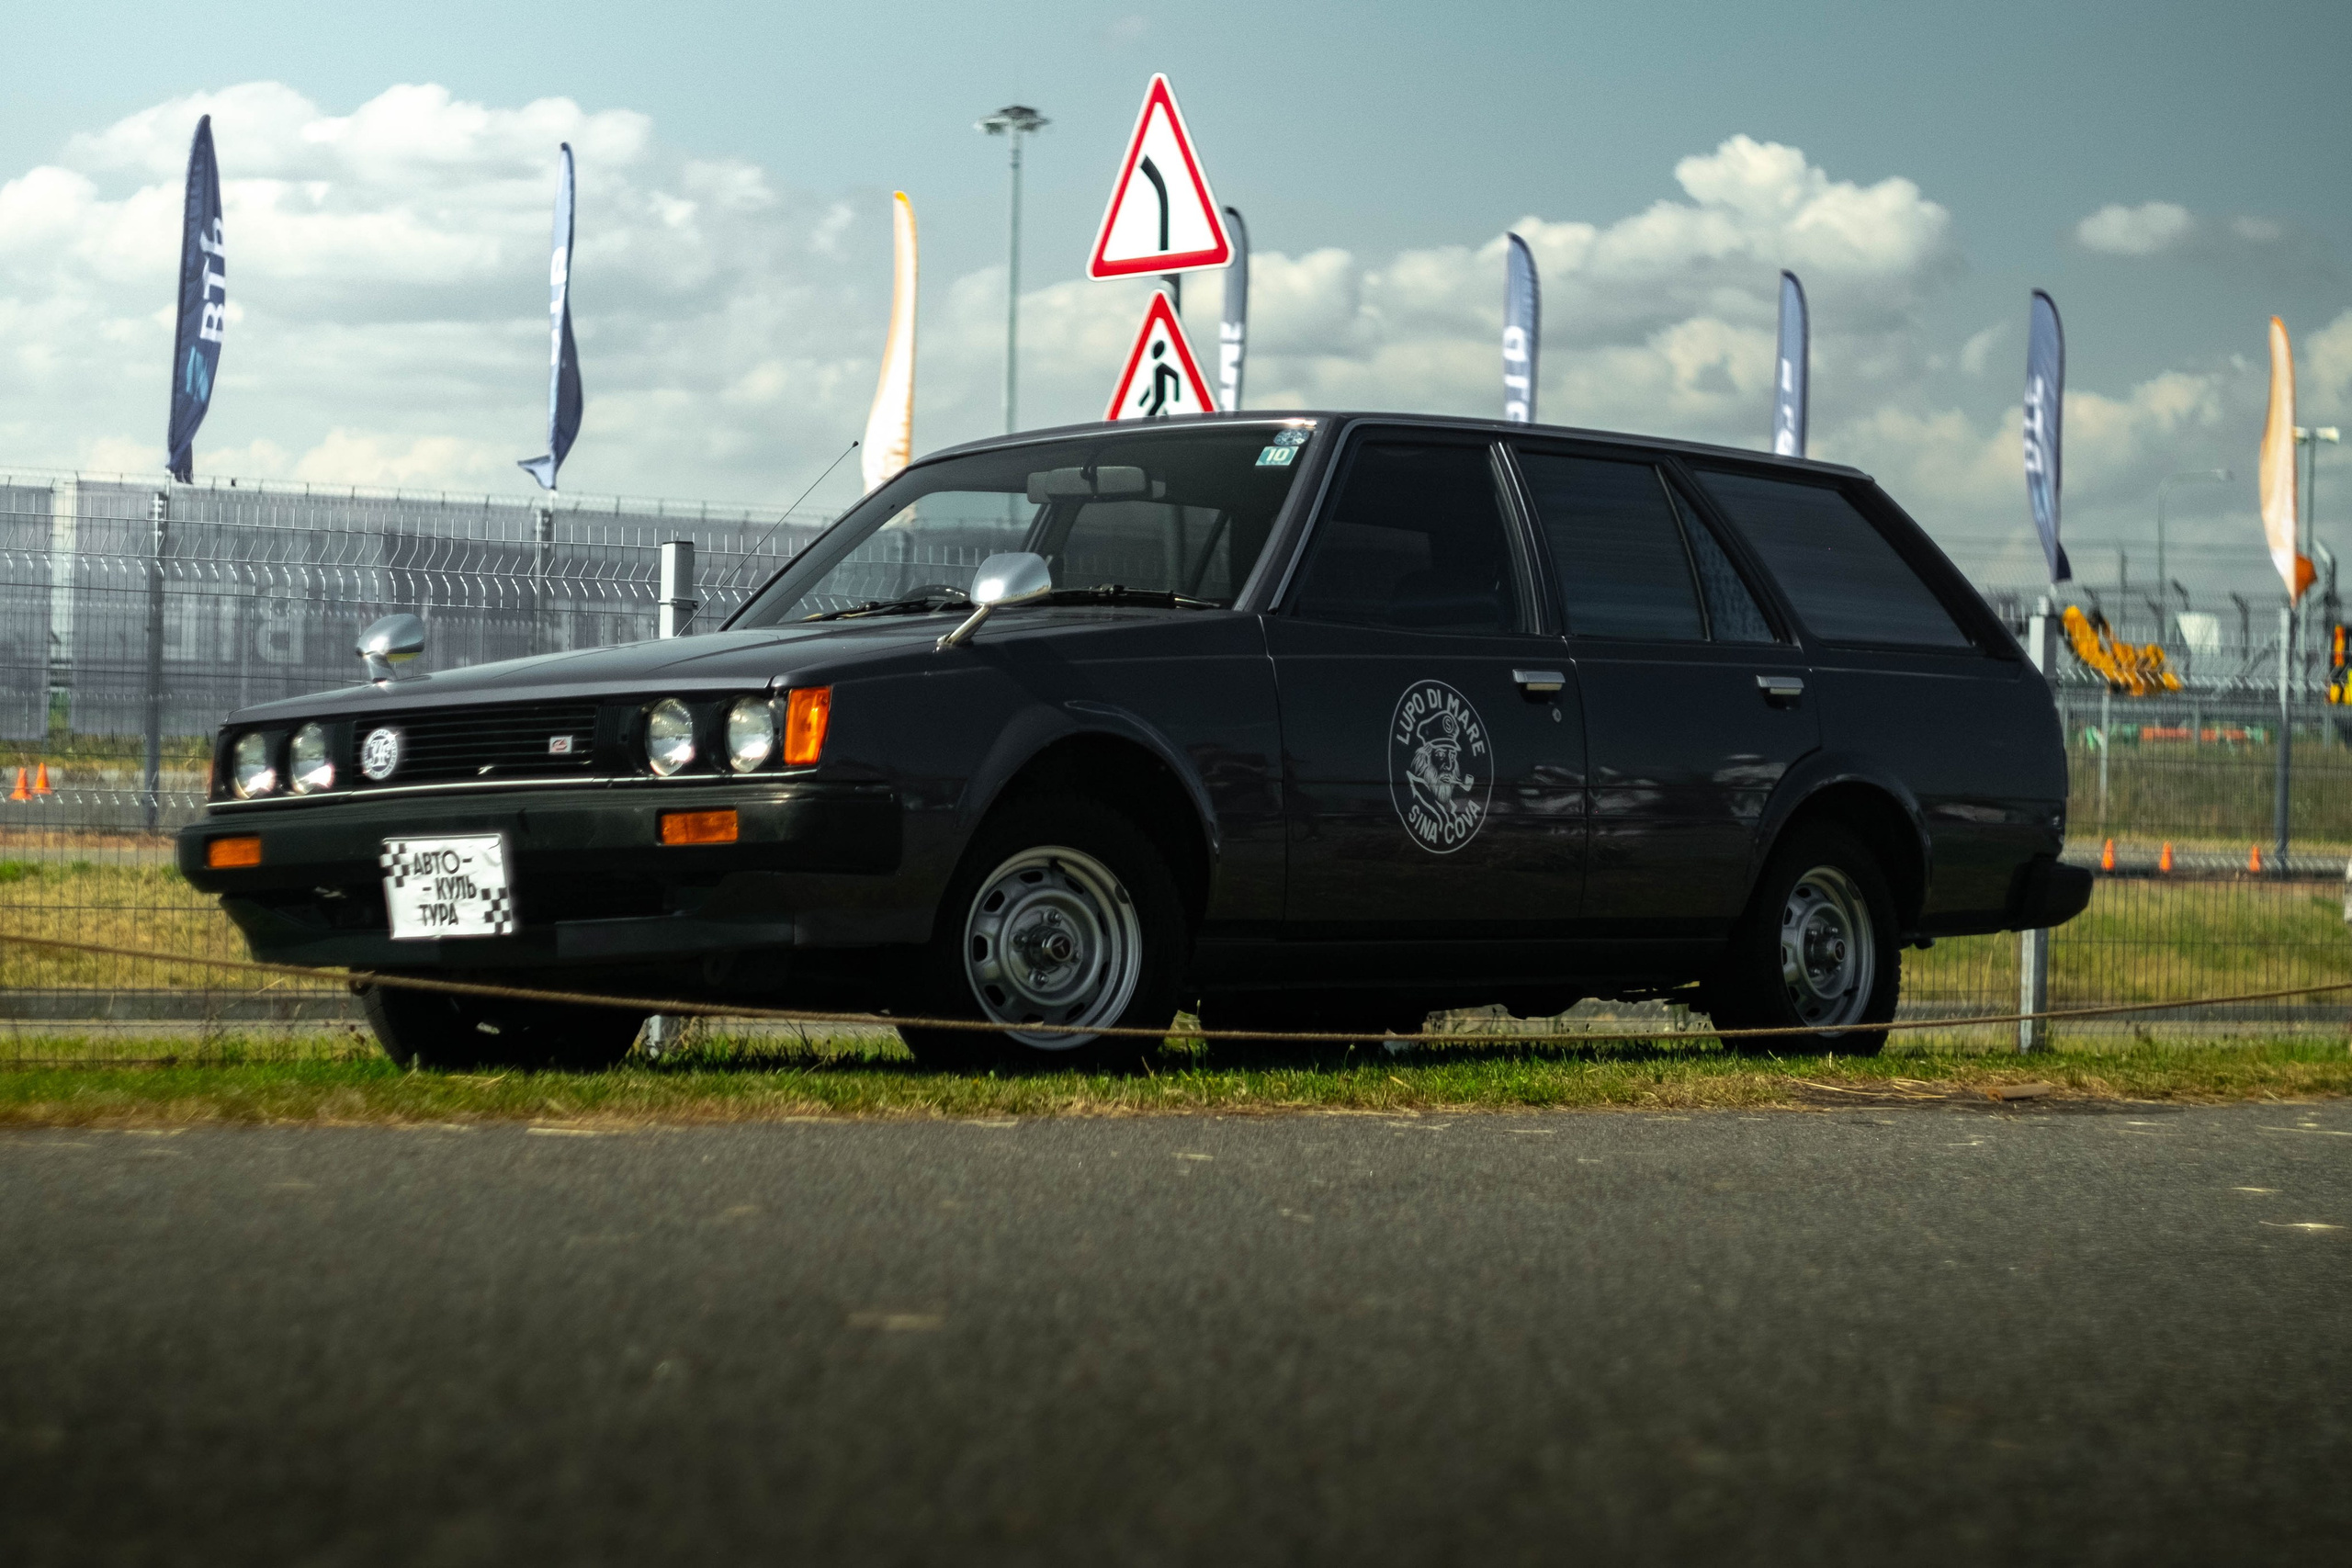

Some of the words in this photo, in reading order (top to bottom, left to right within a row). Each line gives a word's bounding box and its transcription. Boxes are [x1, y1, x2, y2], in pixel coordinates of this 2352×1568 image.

[1266, 447, 1291, 461] 10
[1396, 693, 1425, 745] LUPO
[1427, 689, 1442, 709] DI
[1446, 694, 1486, 757] MARE
[1408, 805, 1437, 843] SINA
[1444, 799, 1481, 844] COVA
[419, 902, 458, 927] ТУРА
